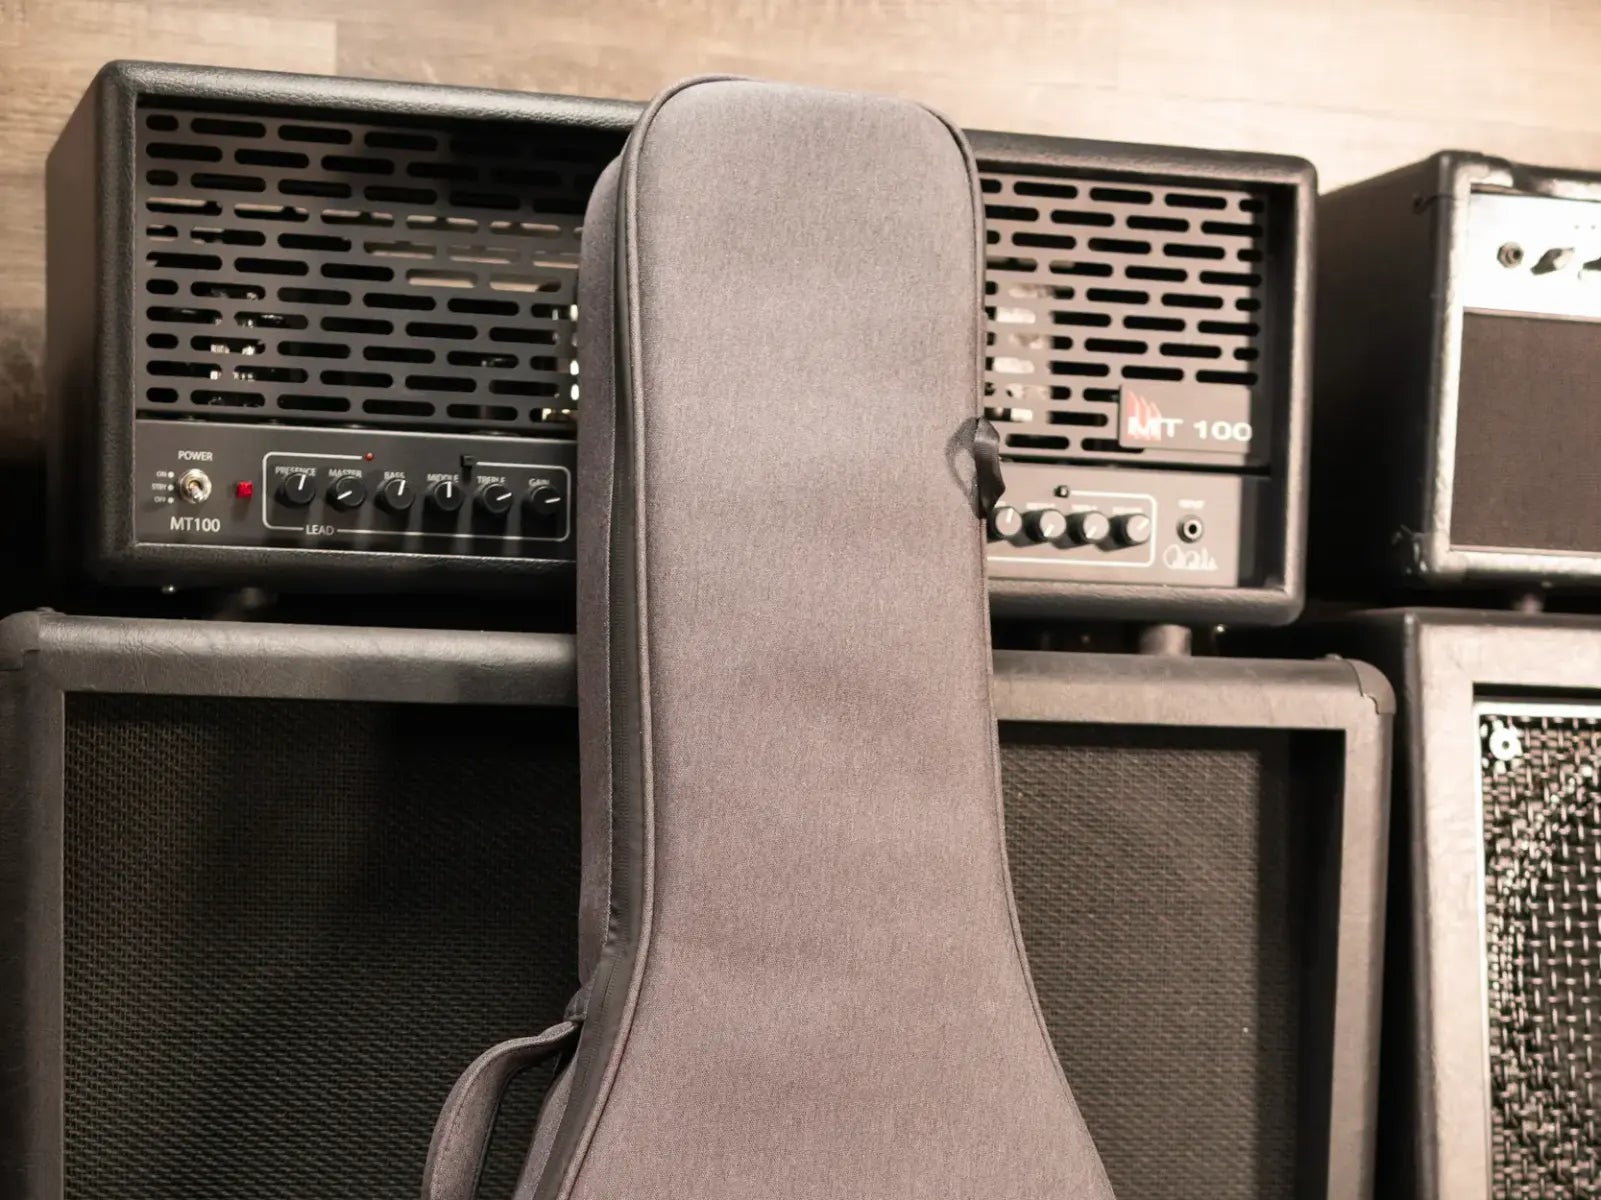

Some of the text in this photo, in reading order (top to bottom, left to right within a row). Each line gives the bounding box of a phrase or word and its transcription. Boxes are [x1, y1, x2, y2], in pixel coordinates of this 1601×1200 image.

[1193, 419, 1253, 442] 100
[177, 450, 214, 461] POWER
[275, 466, 316, 477] PRESENCE
[328, 468, 363, 478] MASTER
[384, 471, 406, 480] BASS
[170, 516, 221, 532] MT100
[306, 524, 335, 536] LEAD
